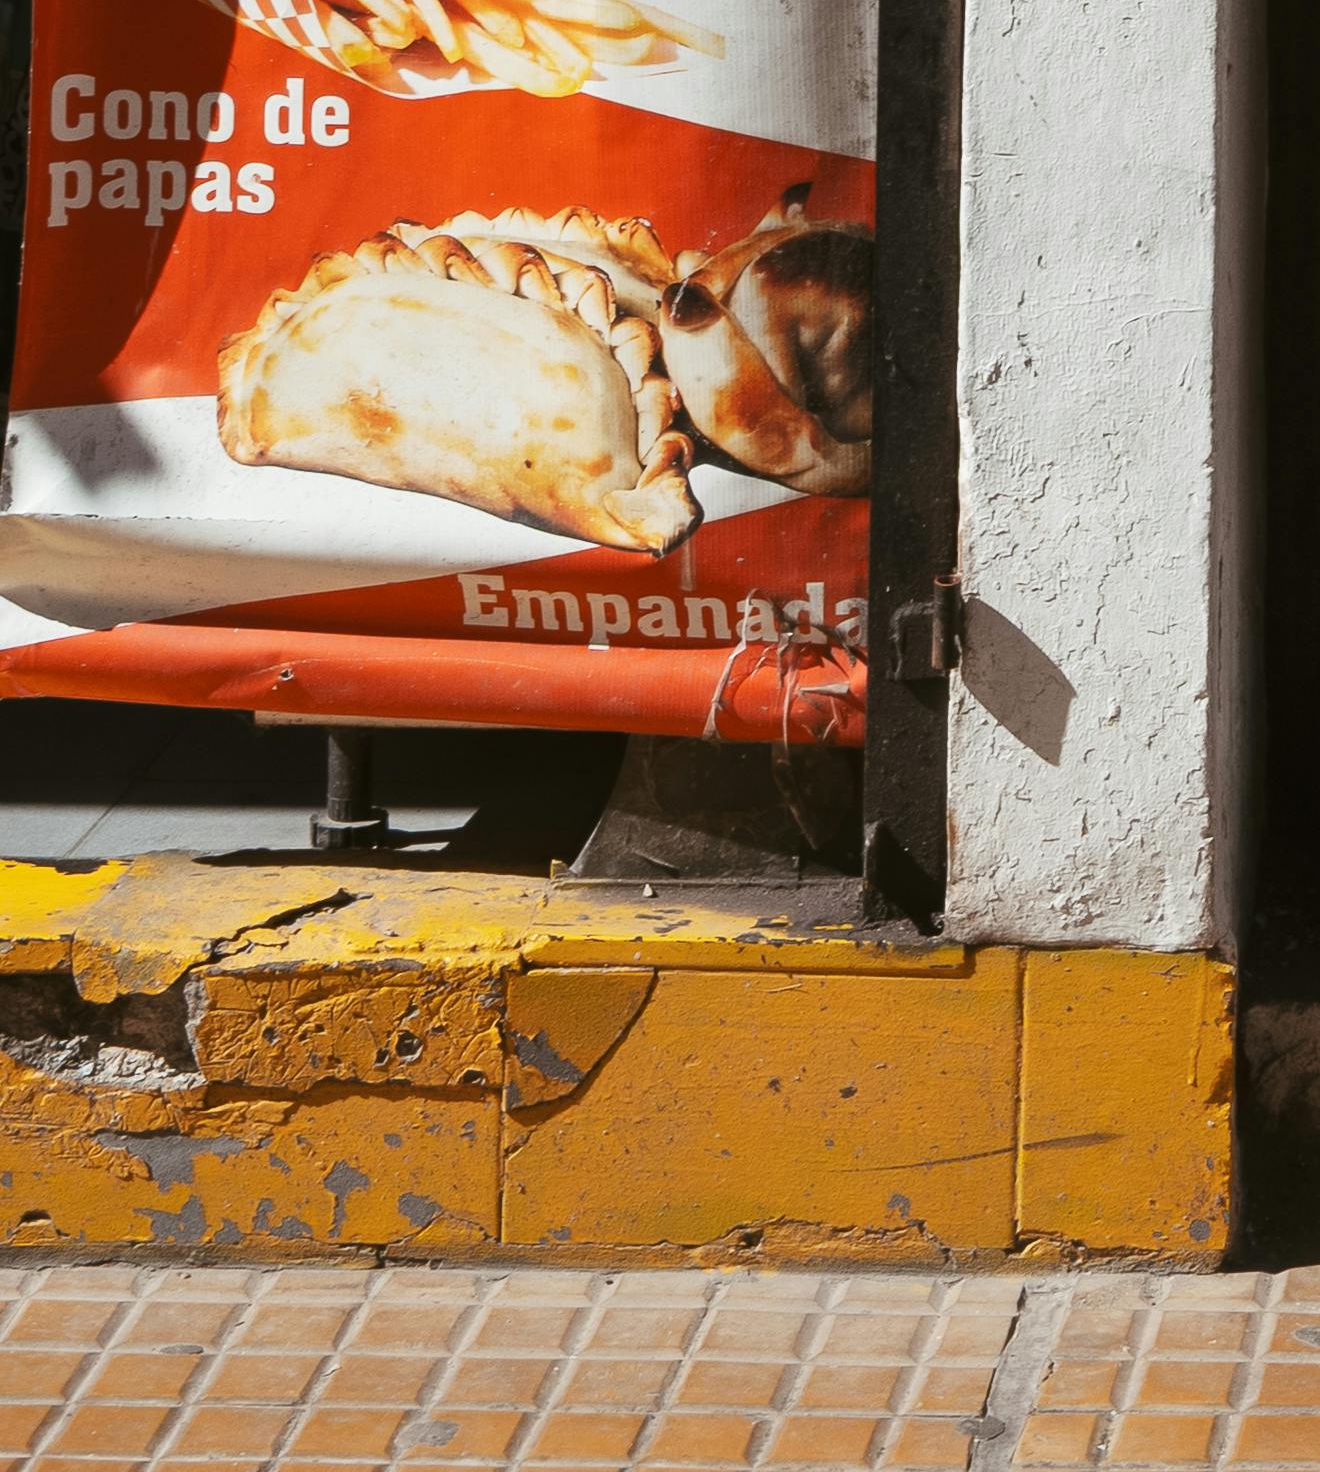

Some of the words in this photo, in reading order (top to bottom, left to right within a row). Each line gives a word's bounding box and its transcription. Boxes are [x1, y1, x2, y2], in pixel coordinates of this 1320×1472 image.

[51, 73, 235, 144] Cono
[263, 77, 350, 147] de
[47, 158, 275, 228] papas
[457, 573, 869, 651] Empanada
